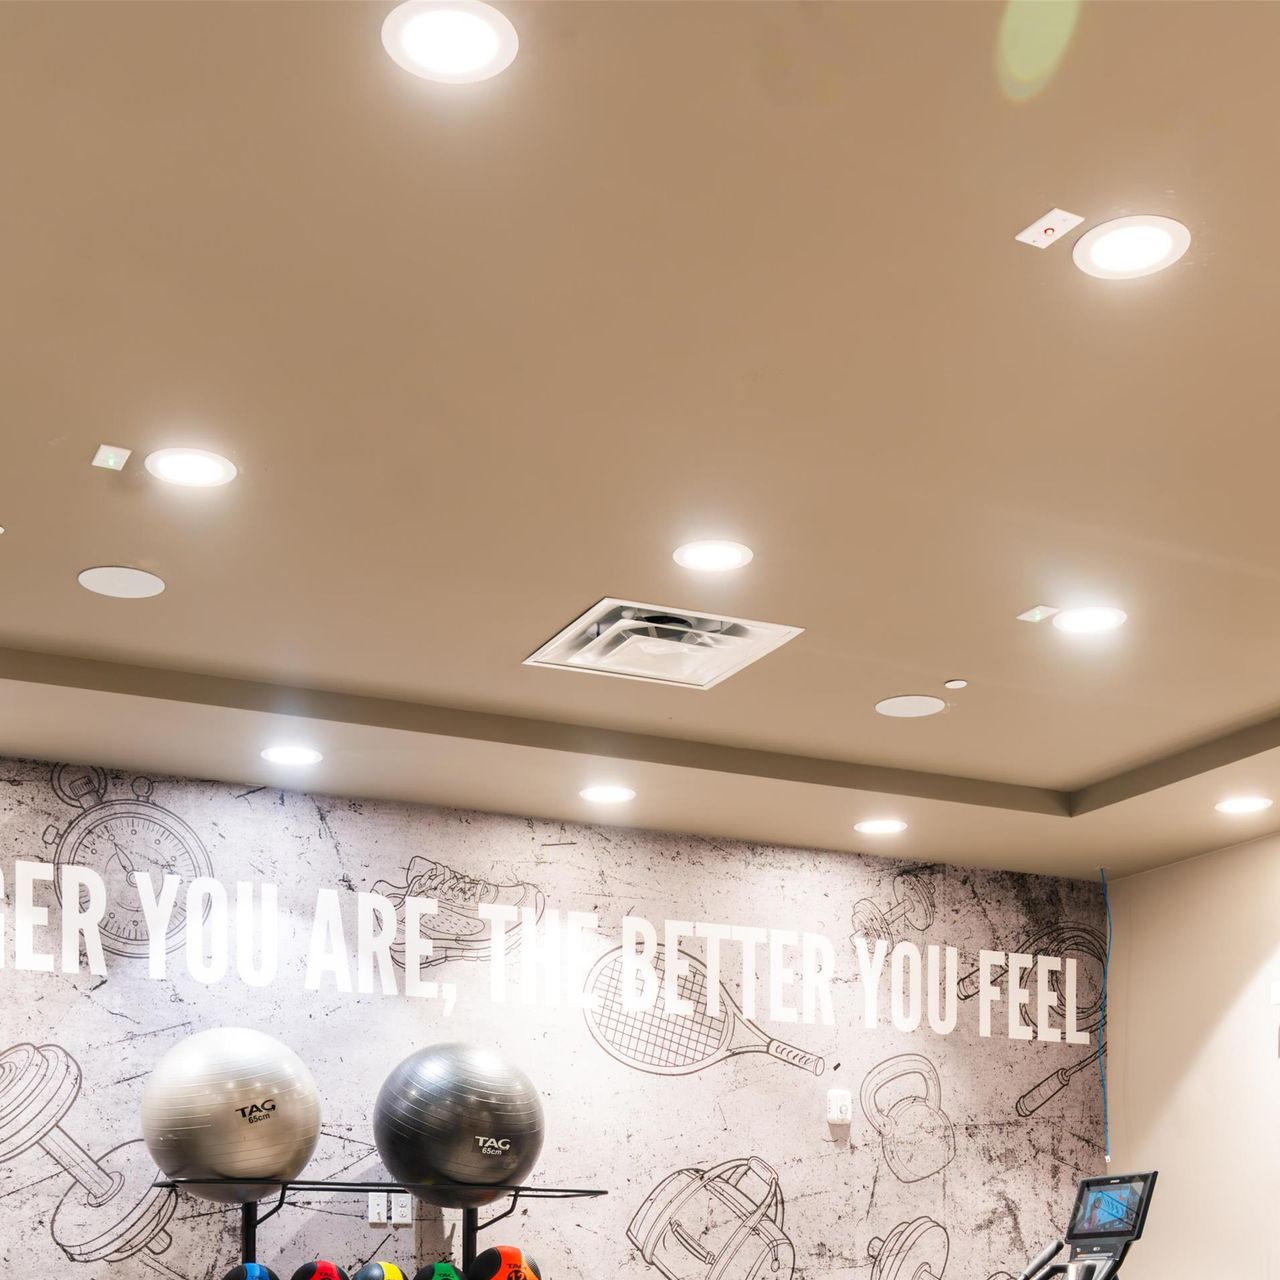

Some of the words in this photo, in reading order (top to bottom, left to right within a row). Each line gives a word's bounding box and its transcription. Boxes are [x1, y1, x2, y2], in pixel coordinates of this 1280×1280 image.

[133, 871, 278, 987] YOU
[304, 888, 457, 1017] ARE,
[478, 902, 600, 1010] THE
[621, 916, 835, 1028] BETTER
[856, 938, 959, 1037] YOU
[980, 951, 1090, 1046] FEEL
[234, 1099, 277, 1119] TAG
[248, 1112, 271, 1124] 65cm
[474, 1136, 512, 1151] TAG
[481, 1147, 503, 1156] 65cm
